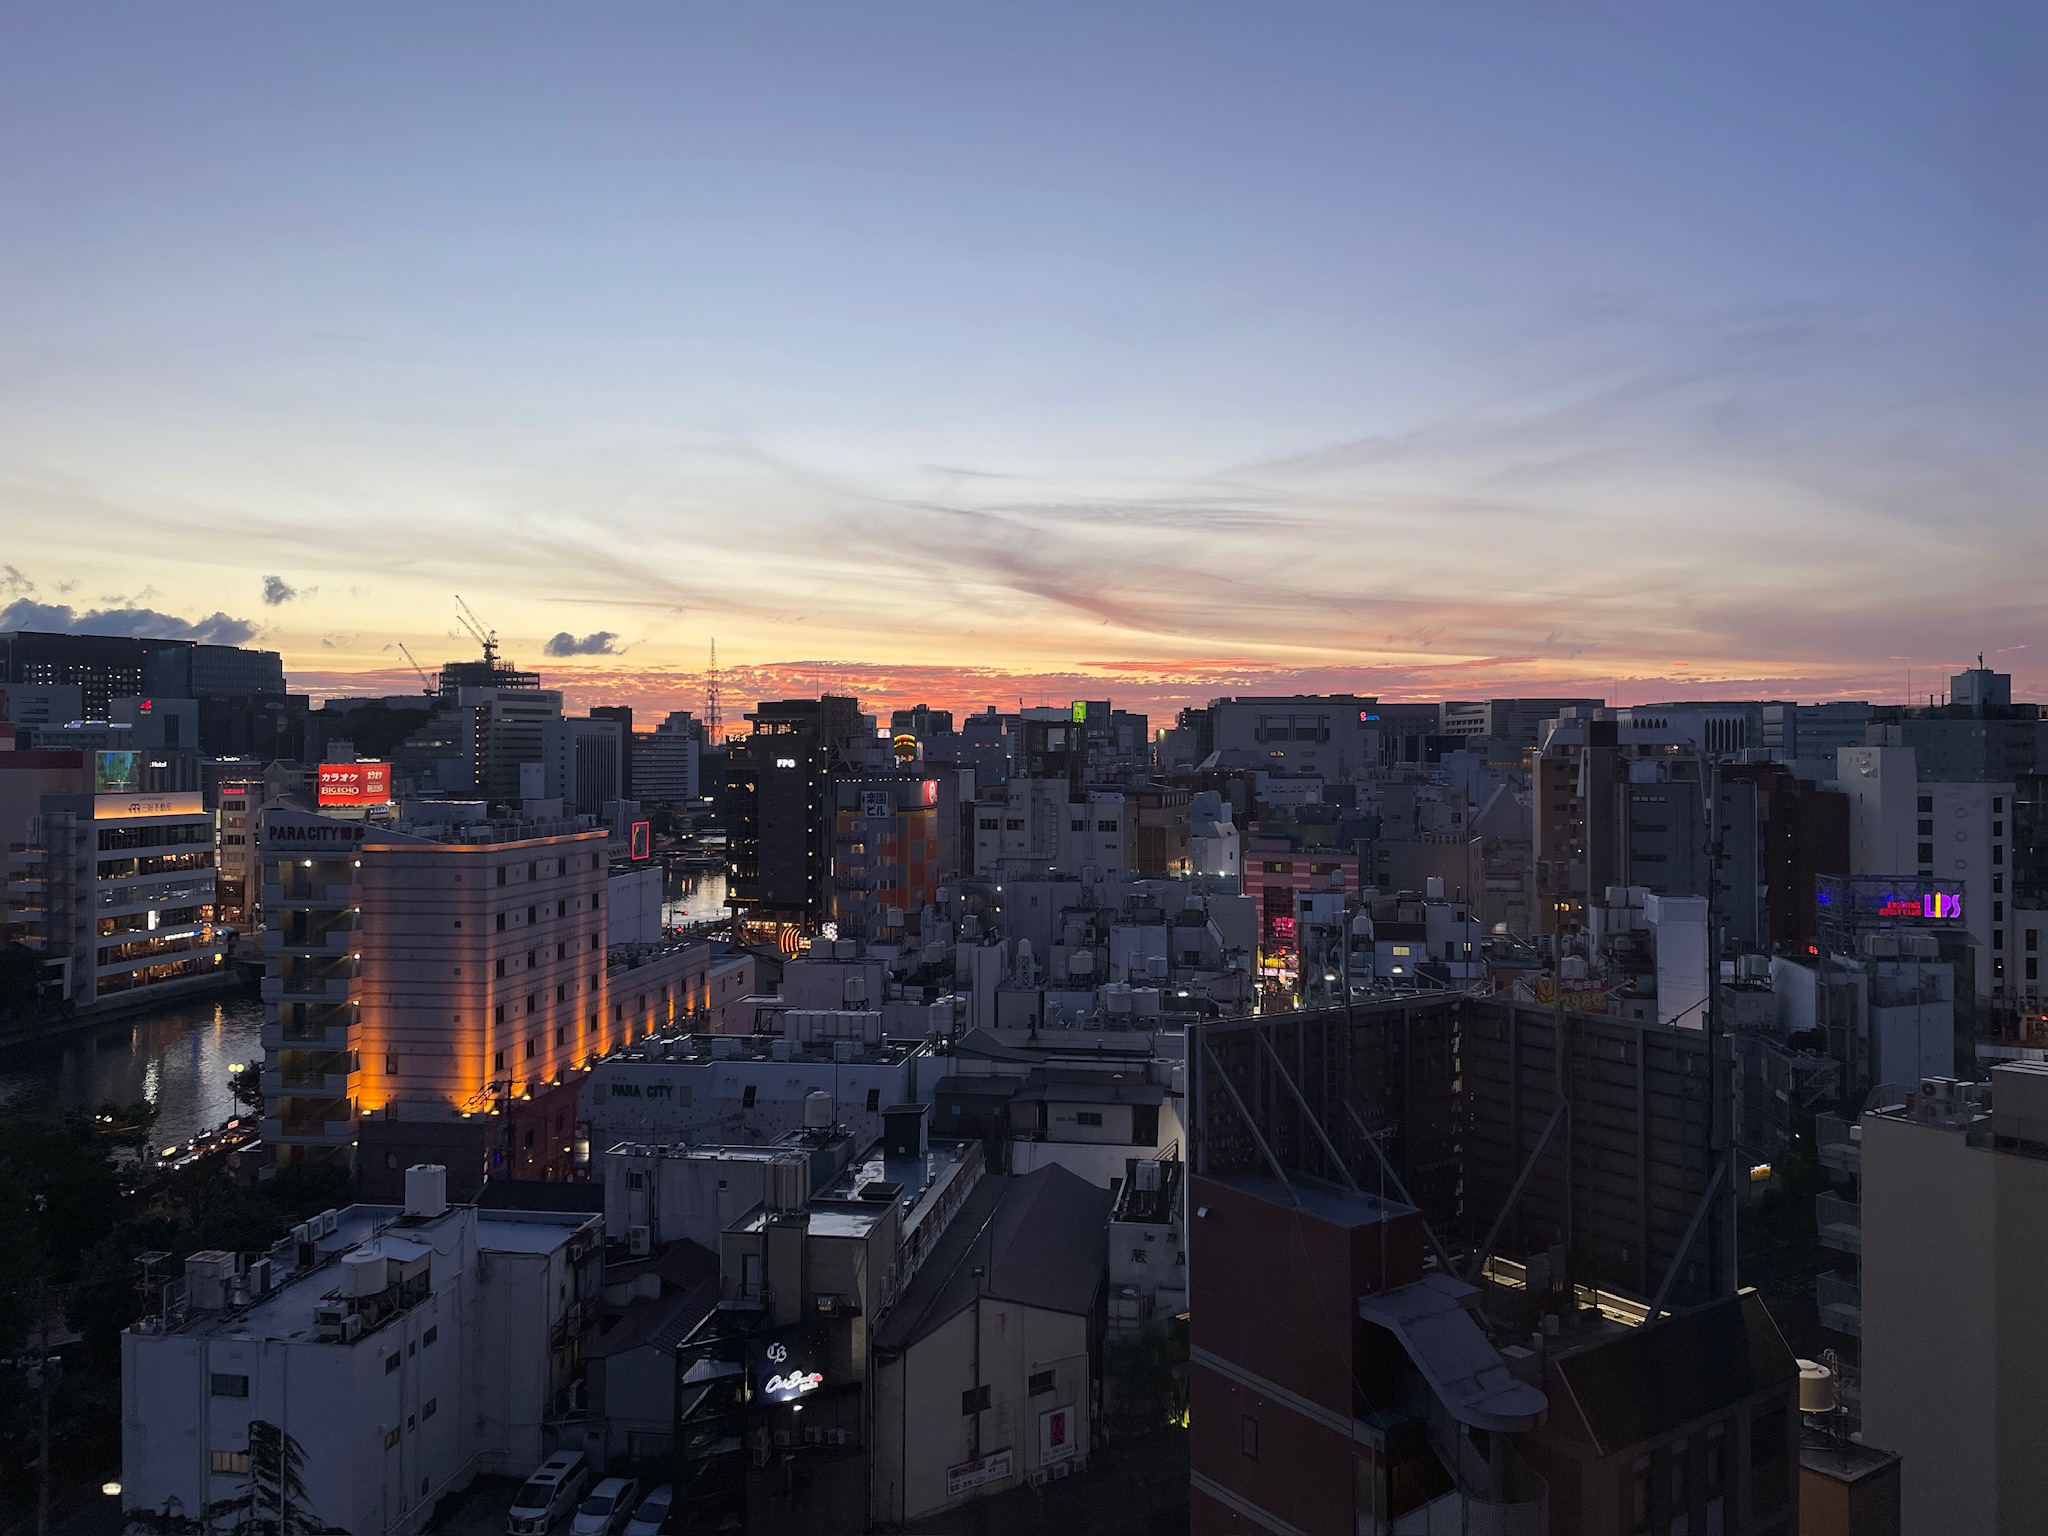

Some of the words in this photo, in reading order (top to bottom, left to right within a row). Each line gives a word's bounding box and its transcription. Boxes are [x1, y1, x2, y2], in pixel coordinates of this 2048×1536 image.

[777, 759, 795, 768] FPG
[321, 773, 359, 782] カラオケ
[321, 787, 336, 795] BIG
[338, 787, 360, 795] ECHO
[867, 805, 886, 817] ビル
[1923, 891, 1961, 918] LIPS
[612, 1084, 640, 1096] PARA
[647, 1085, 674, 1098] CITY
